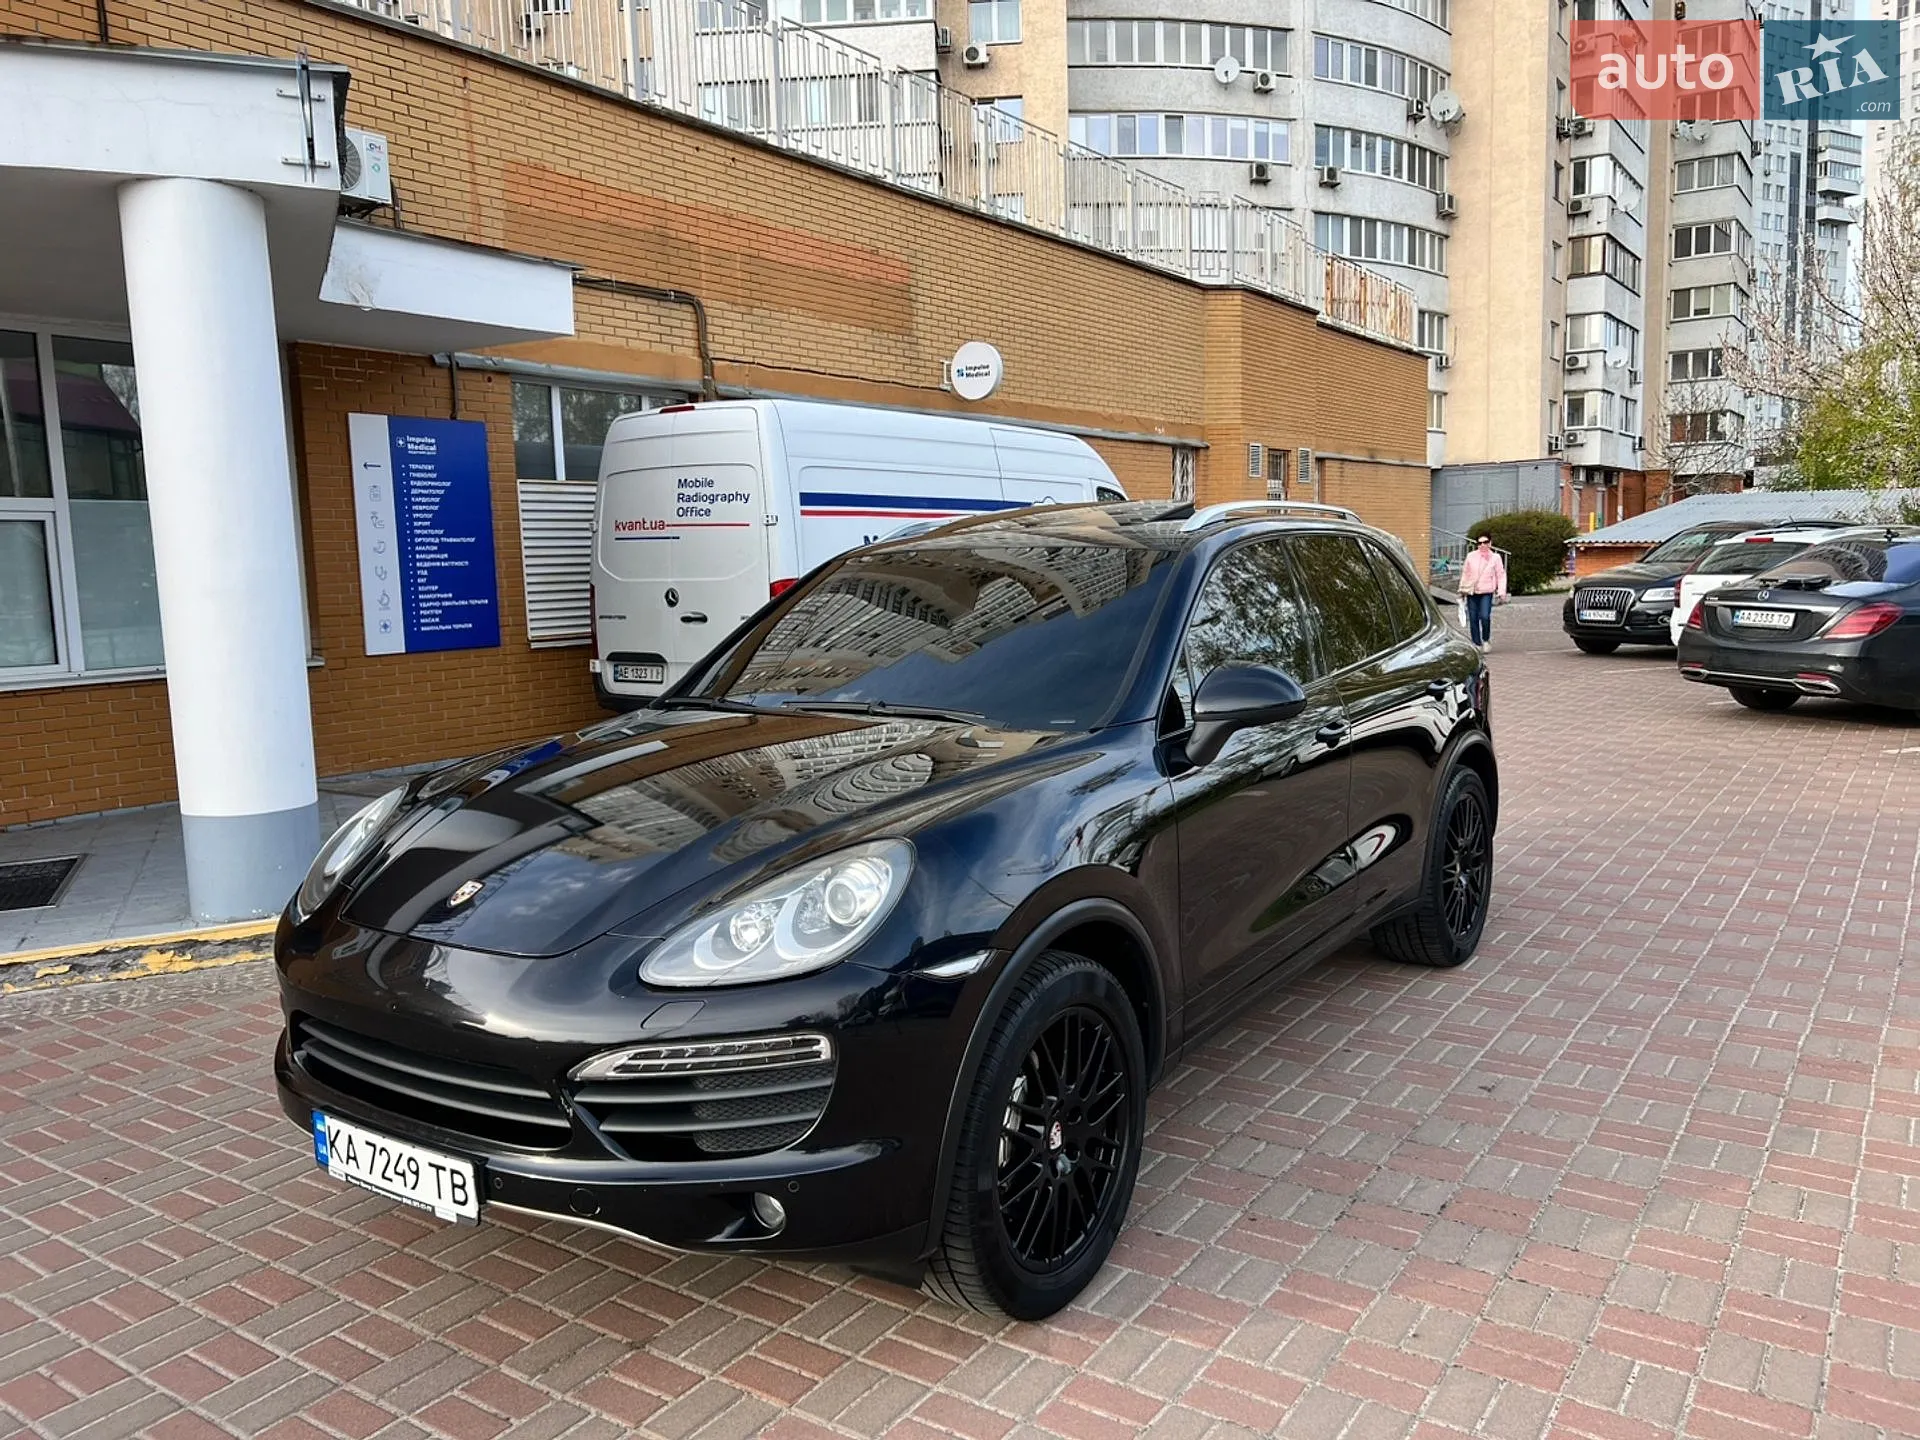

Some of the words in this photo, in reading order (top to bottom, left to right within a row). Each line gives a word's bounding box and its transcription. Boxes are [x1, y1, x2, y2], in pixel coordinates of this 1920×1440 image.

[965, 370, 990, 378] Medical
[407, 435, 436, 444] Impulse
[677, 477, 715, 489] Mobile
[677, 491, 750, 505] Radiography
[676, 506, 711, 518] Office
[614, 517, 666, 531] kvant.ua
[619, 667, 629, 678] AE
[631, 668, 648, 679] 1323
[327, 1125, 361, 1170] KA
[365, 1140, 420, 1191] 7249
[428, 1162, 469, 1207] TB
